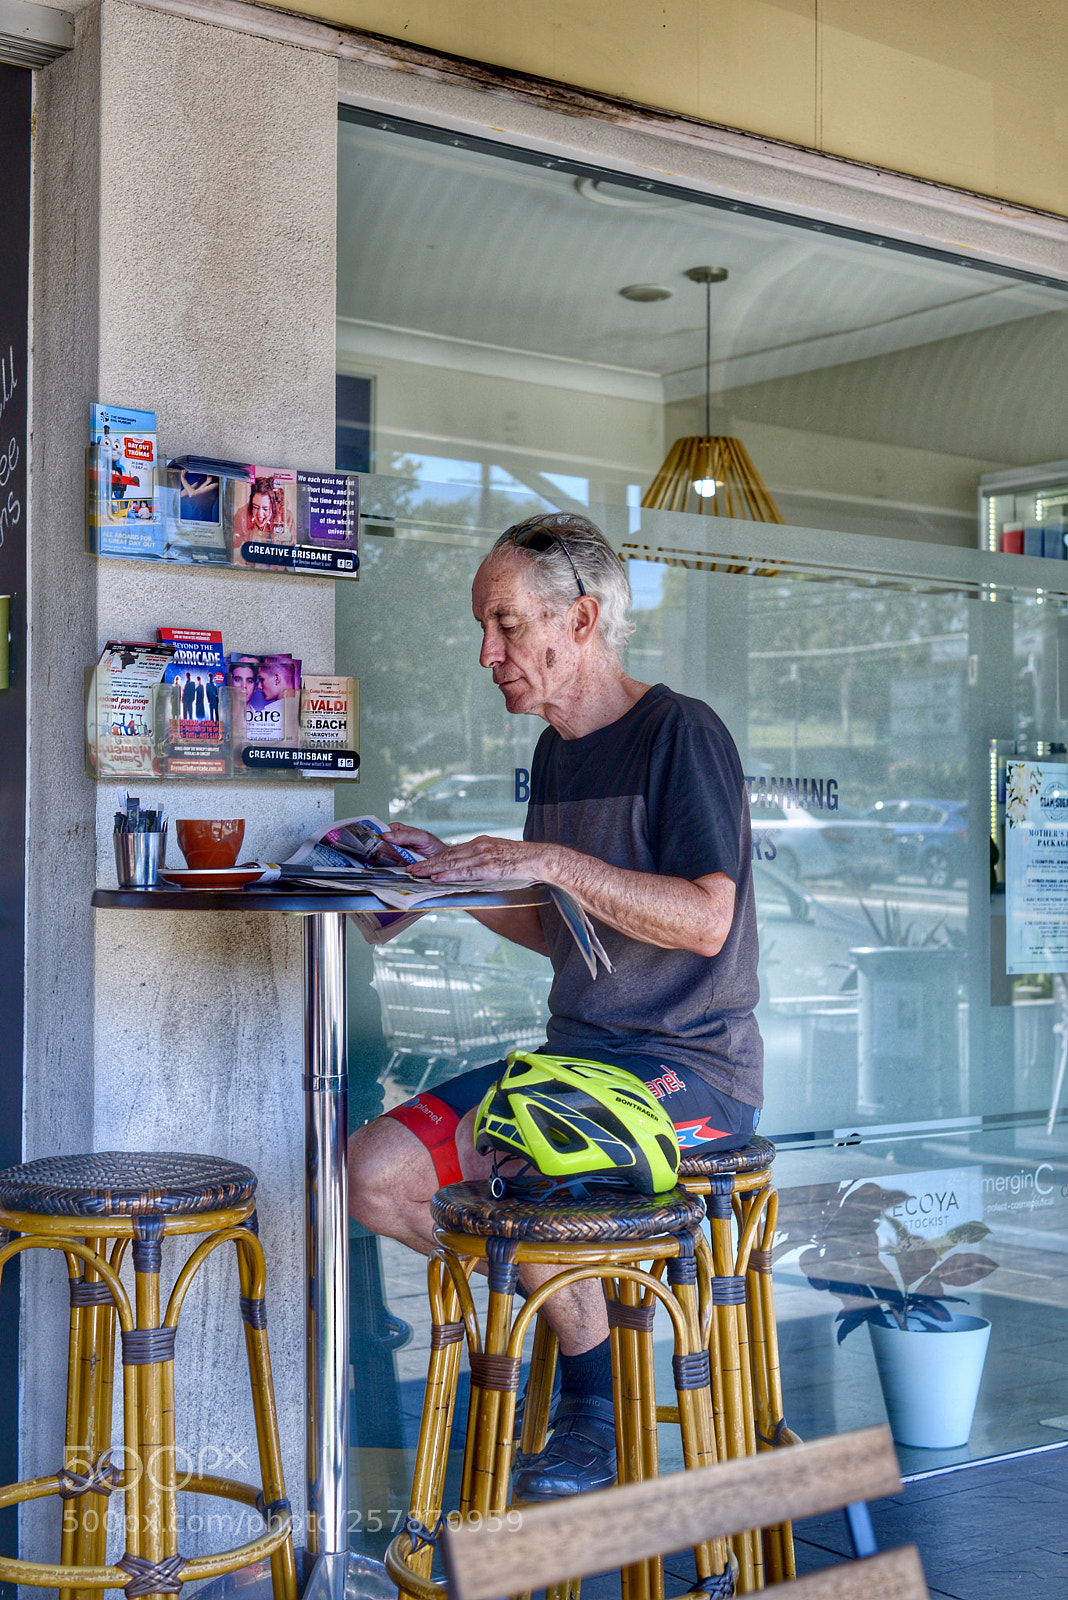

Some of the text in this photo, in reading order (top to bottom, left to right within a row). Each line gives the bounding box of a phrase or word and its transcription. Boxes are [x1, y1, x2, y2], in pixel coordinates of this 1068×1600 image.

[248, 545, 333, 561] CREATIVE BRISBANE
[169, 650, 221, 666] ARRICADE
[302, 700, 347, 711] VIVALDI
[249, 750, 332, 760] CREATIVE BRISBANE
[302, 740, 348, 749] AGANINI
[744, 776, 838, 810] TANNING
[645, 1064, 686, 1100] anet
[413, 1103, 443, 1125] planet
[616, 1096, 659, 1121] BONTRAGER
[980, 1163, 1054, 1195] merginC
[893, 1191, 959, 1217] ECOYA
